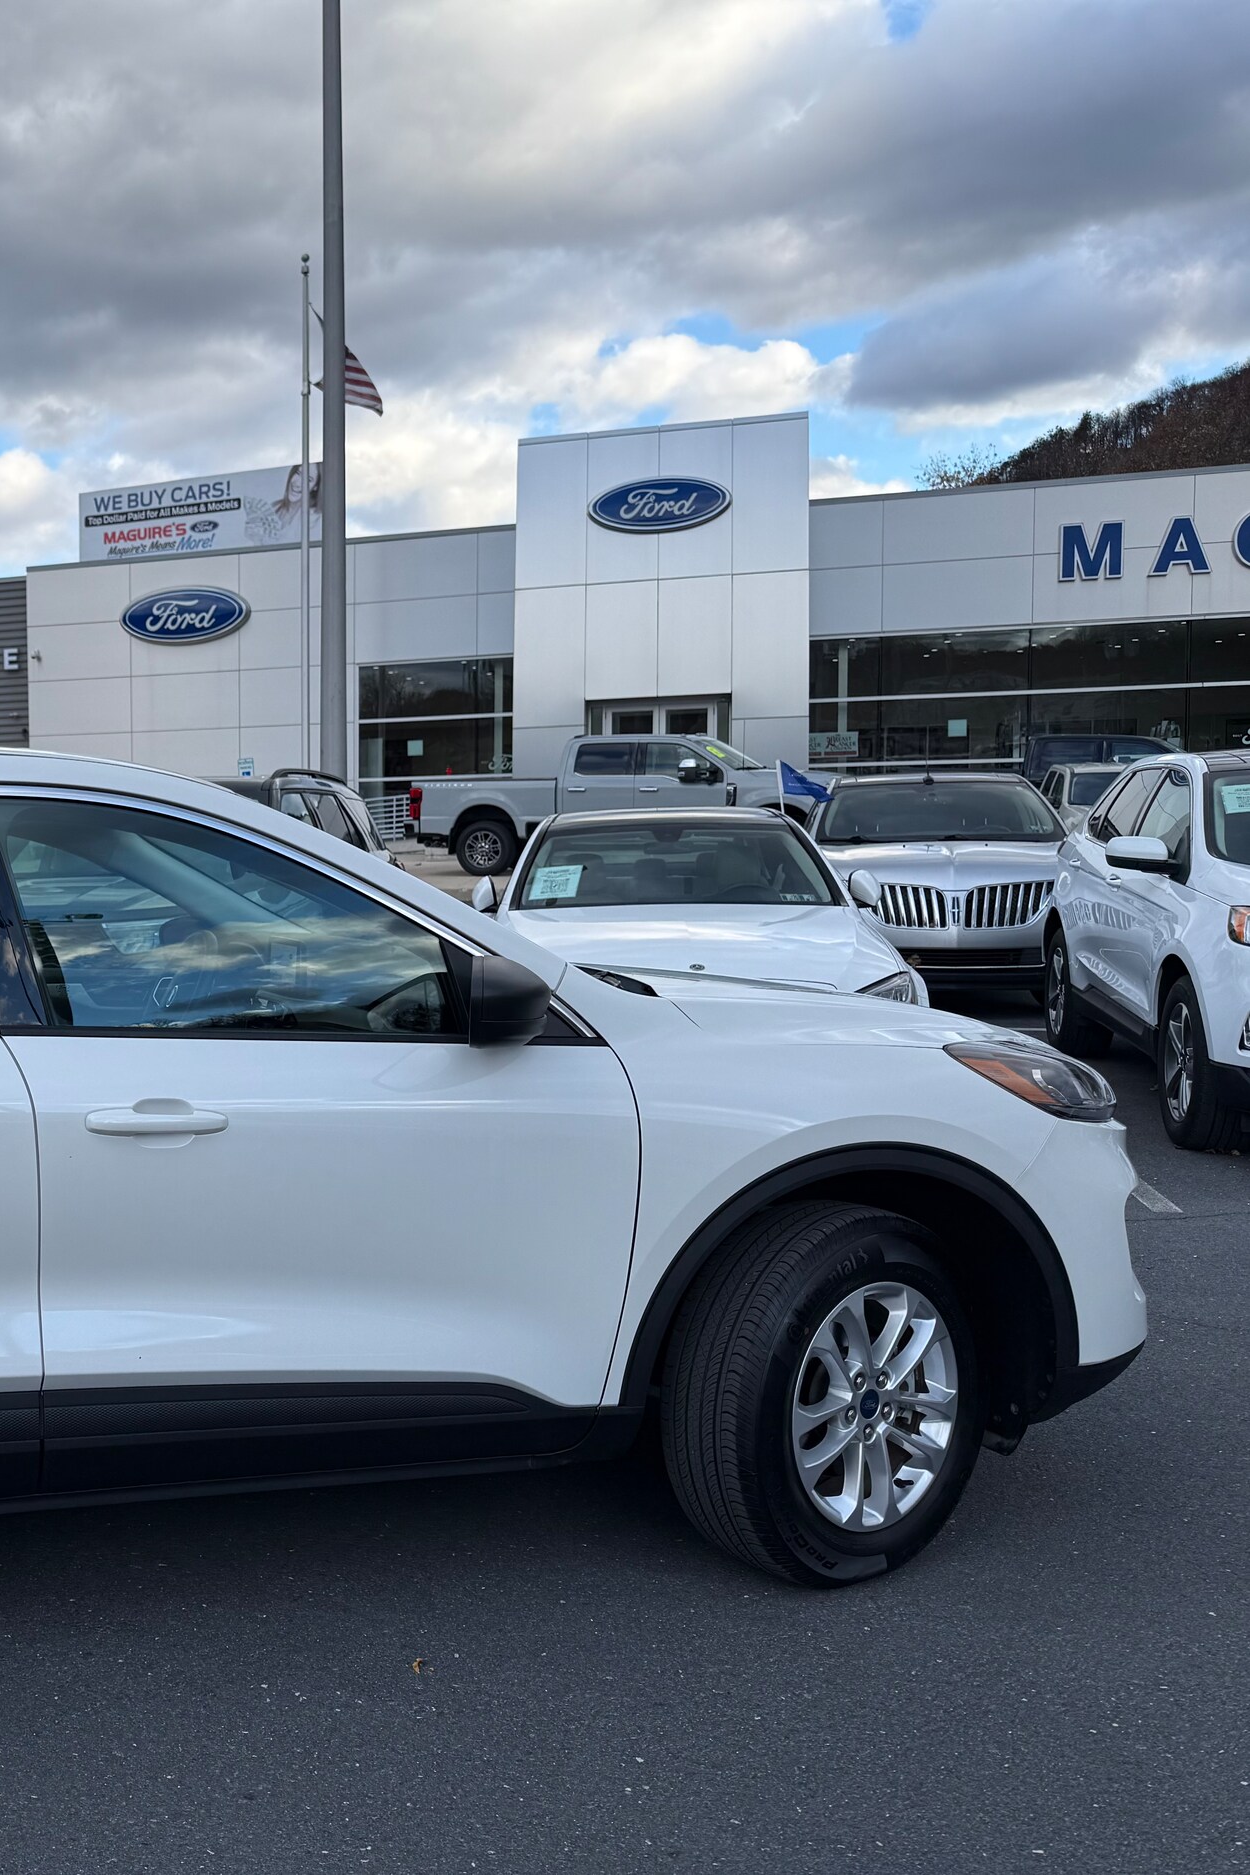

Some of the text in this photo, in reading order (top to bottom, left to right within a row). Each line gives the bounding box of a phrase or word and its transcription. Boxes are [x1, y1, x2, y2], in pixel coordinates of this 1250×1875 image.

[94, 480, 230, 513] WE BUY CARS!
[619, 488, 698, 519] Ford
[88, 500, 238, 526] Top Dollar Paid for All Makes & Models
[104, 522, 187, 545] MAGUIRE'S
[107, 532, 216, 559] Maguire's Means More!
[145, 599, 217, 632] Ford
